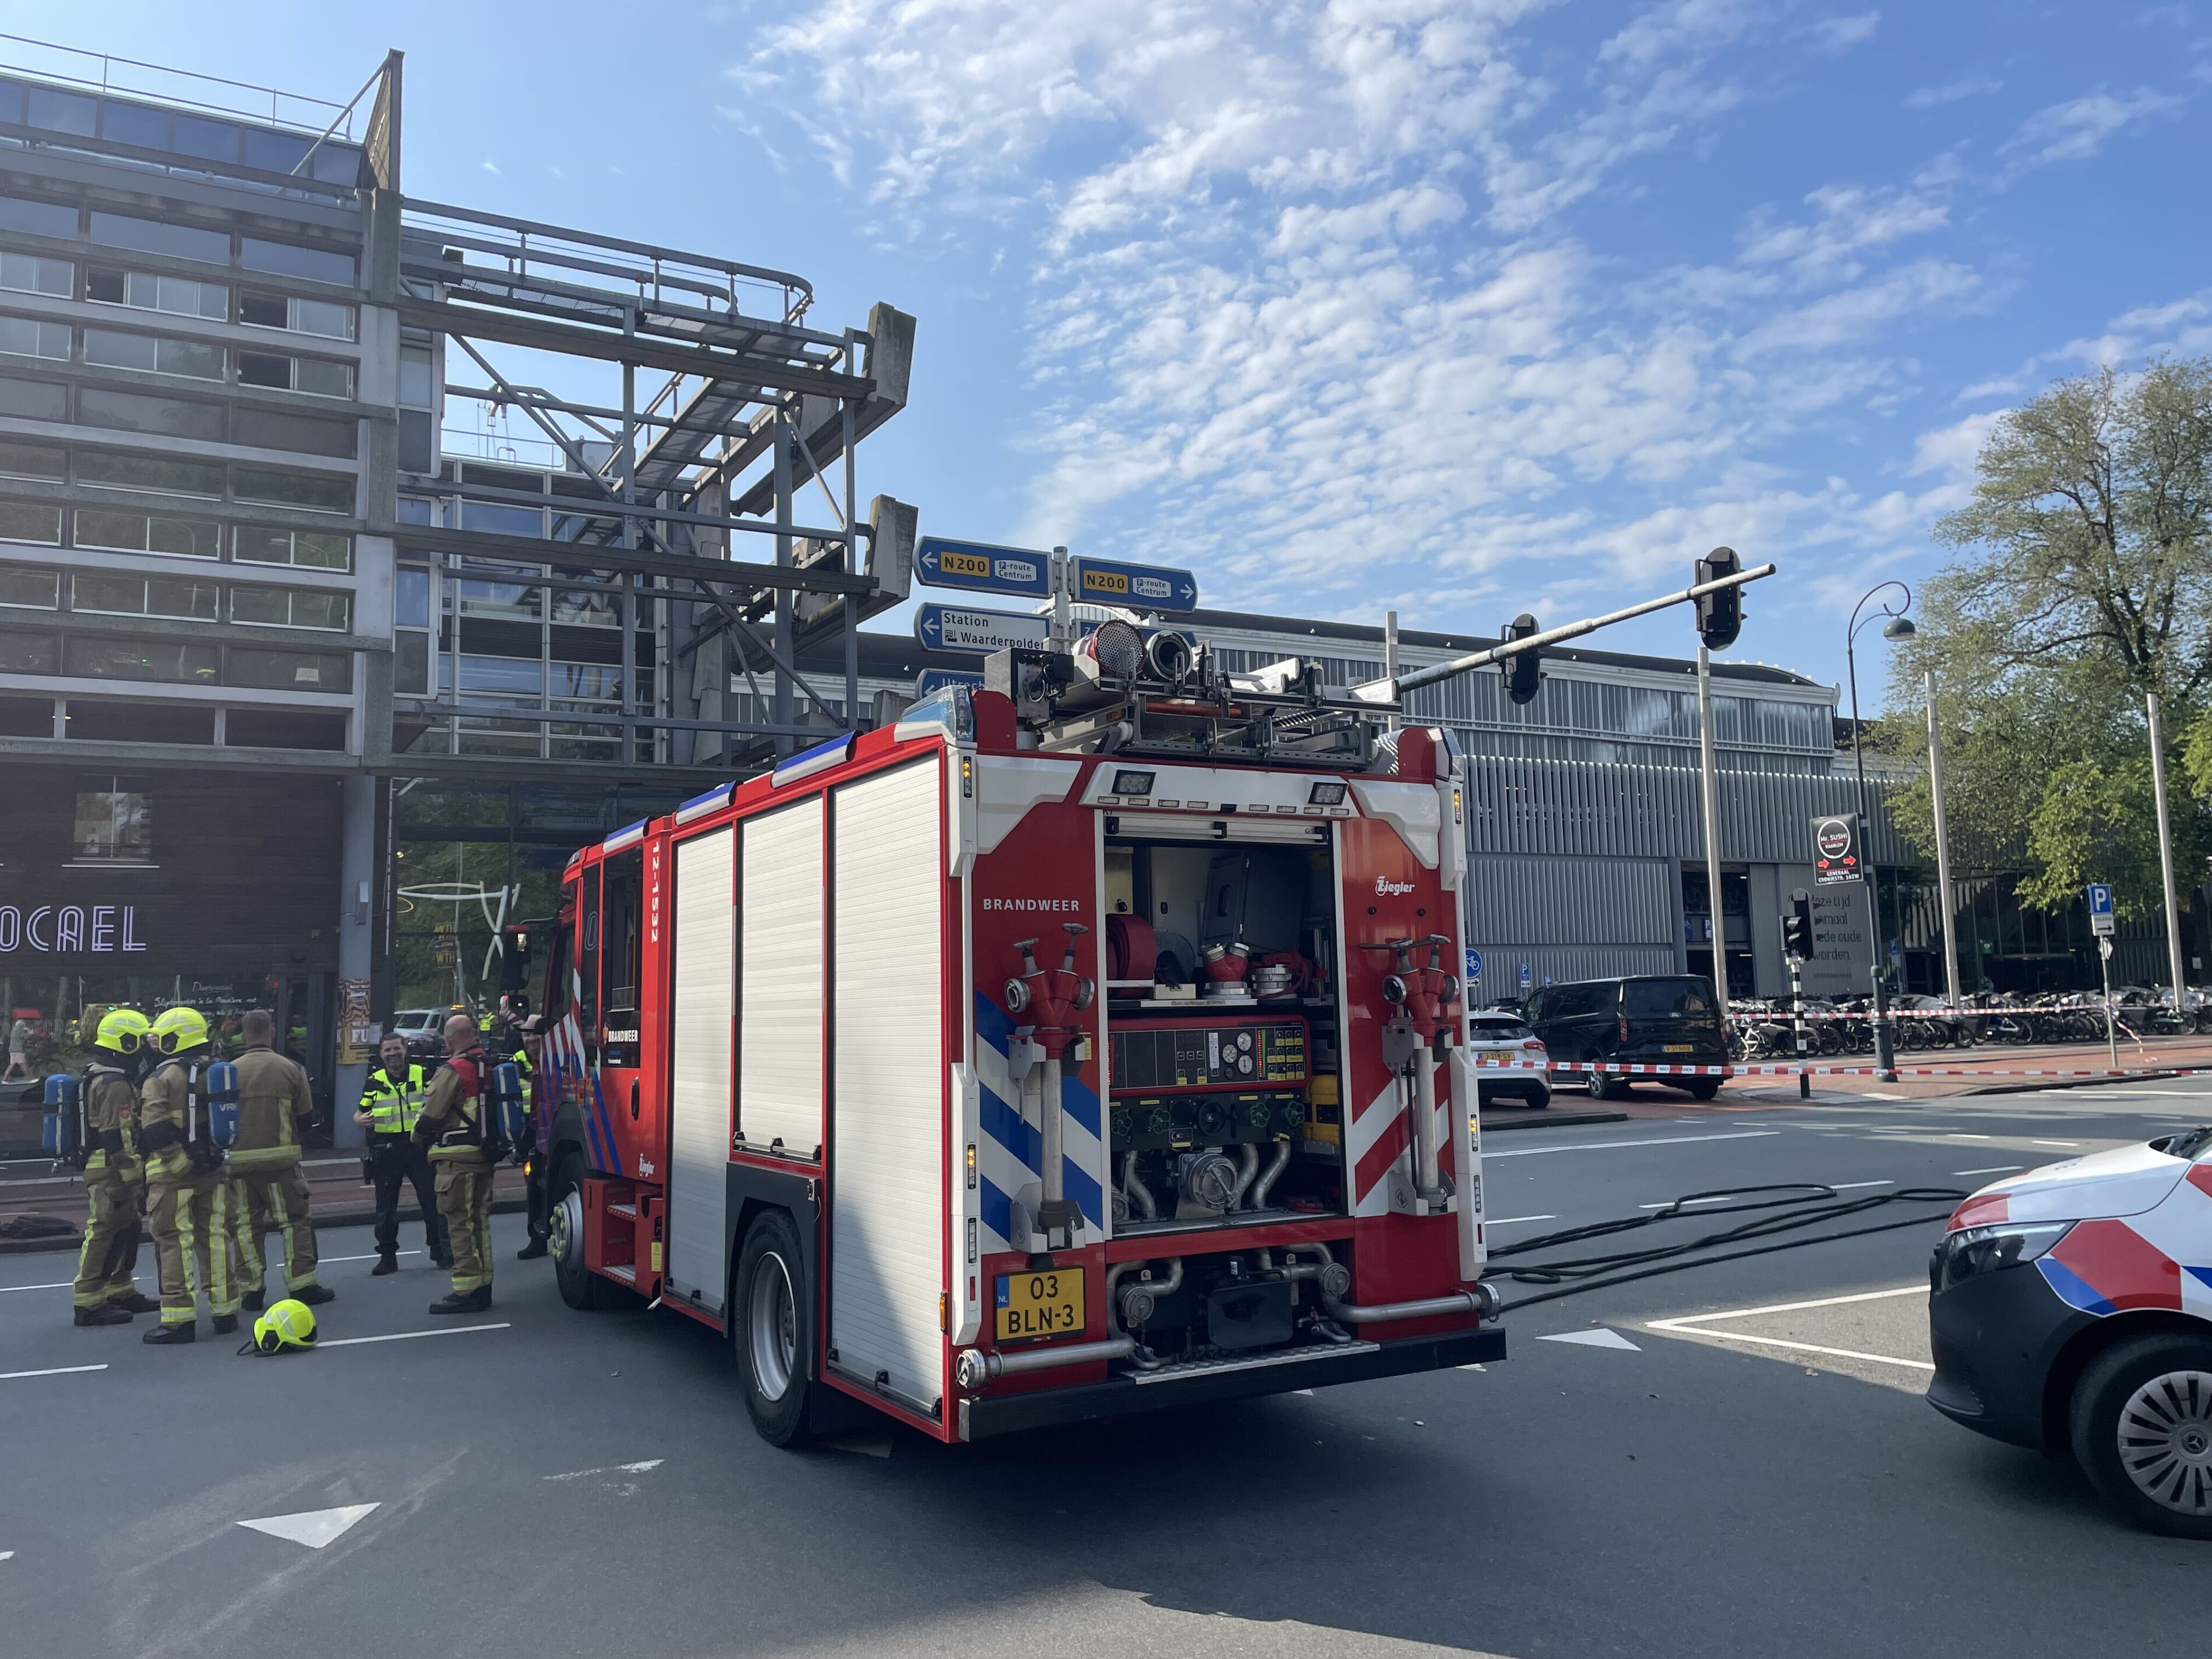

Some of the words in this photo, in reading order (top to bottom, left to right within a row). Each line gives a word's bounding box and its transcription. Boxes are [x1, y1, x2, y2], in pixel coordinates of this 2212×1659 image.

[945, 556, 986, 572] N200
[999, 570, 1032, 580] Centrum
[1087, 574, 1124, 589] N200
[1137, 587, 1167, 596] Centrum
[944, 613, 989, 627] Station
[961, 631, 1043, 650] Waarderpolder
[943, 677, 985, 690] Utrech
[651, 841, 659, 944] 12-1532
[1375, 876, 1415, 896] Ziegler
[983, 899, 1079, 911] BRANDWEER
[2095, 888, 2107, 911] P
[1838, 930, 1862, 943] oude
[1522, 965, 1527, 973] P
[608, 1030, 638, 1042] BRANDWEER
[1030, 1275, 1059, 1300] 03
[999, 1295, 1008, 1303] NL
[1008, 1304, 1074, 1334] BLN-3
